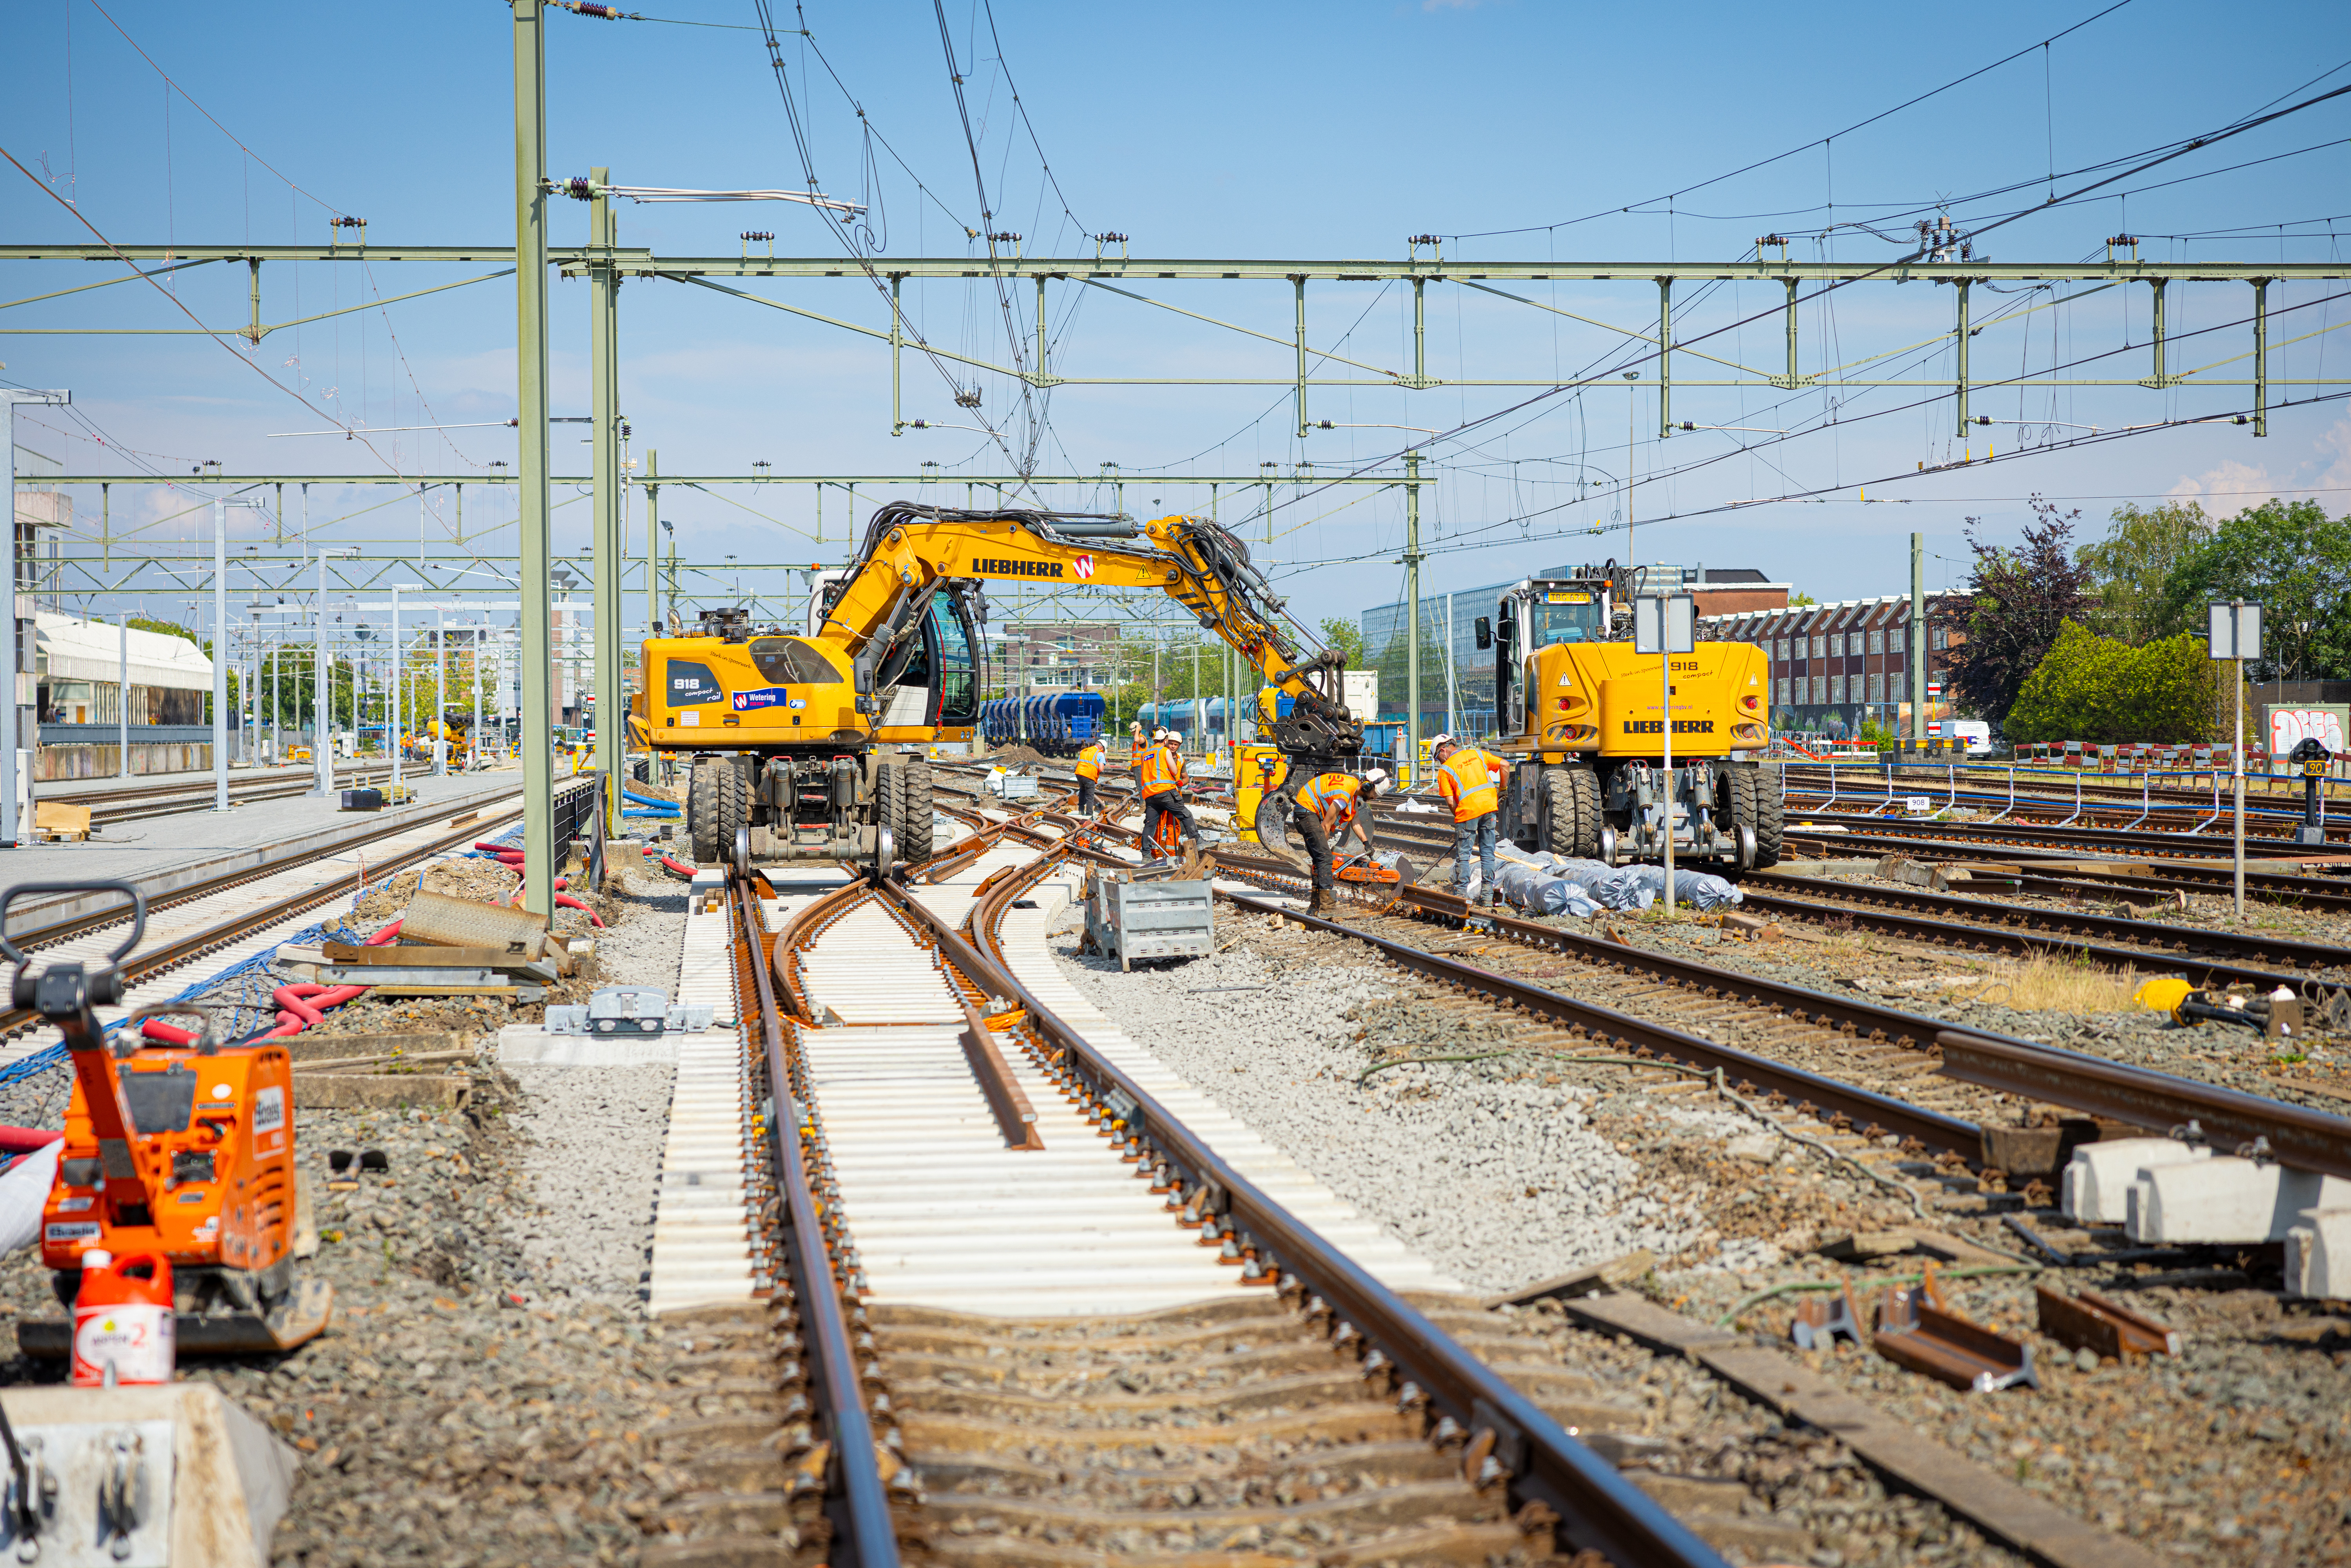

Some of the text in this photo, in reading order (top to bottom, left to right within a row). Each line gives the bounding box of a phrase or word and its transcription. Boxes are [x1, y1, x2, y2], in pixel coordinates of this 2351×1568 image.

[973, 558, 1063, 578] LIEBHERR
[1072, 554, 1094, 579] W
[728, 658, 752, 669] Spoorwerk
[1671, 662, 1698, 671] 918
[1683, 670, 1713, 679] compact
[674, 679, 699, 689] 918
[685, 687, 713, 697] compact
[707, 692, 721, 701] rail
[735, 694, 747, 708] W
[749, 693, 776, 702] Wetering
[1624, 721, 1714, 733] LIEBHERR
[2310, 763, 2322, 773] 90
[130, 1322, 146, 1348] 2
